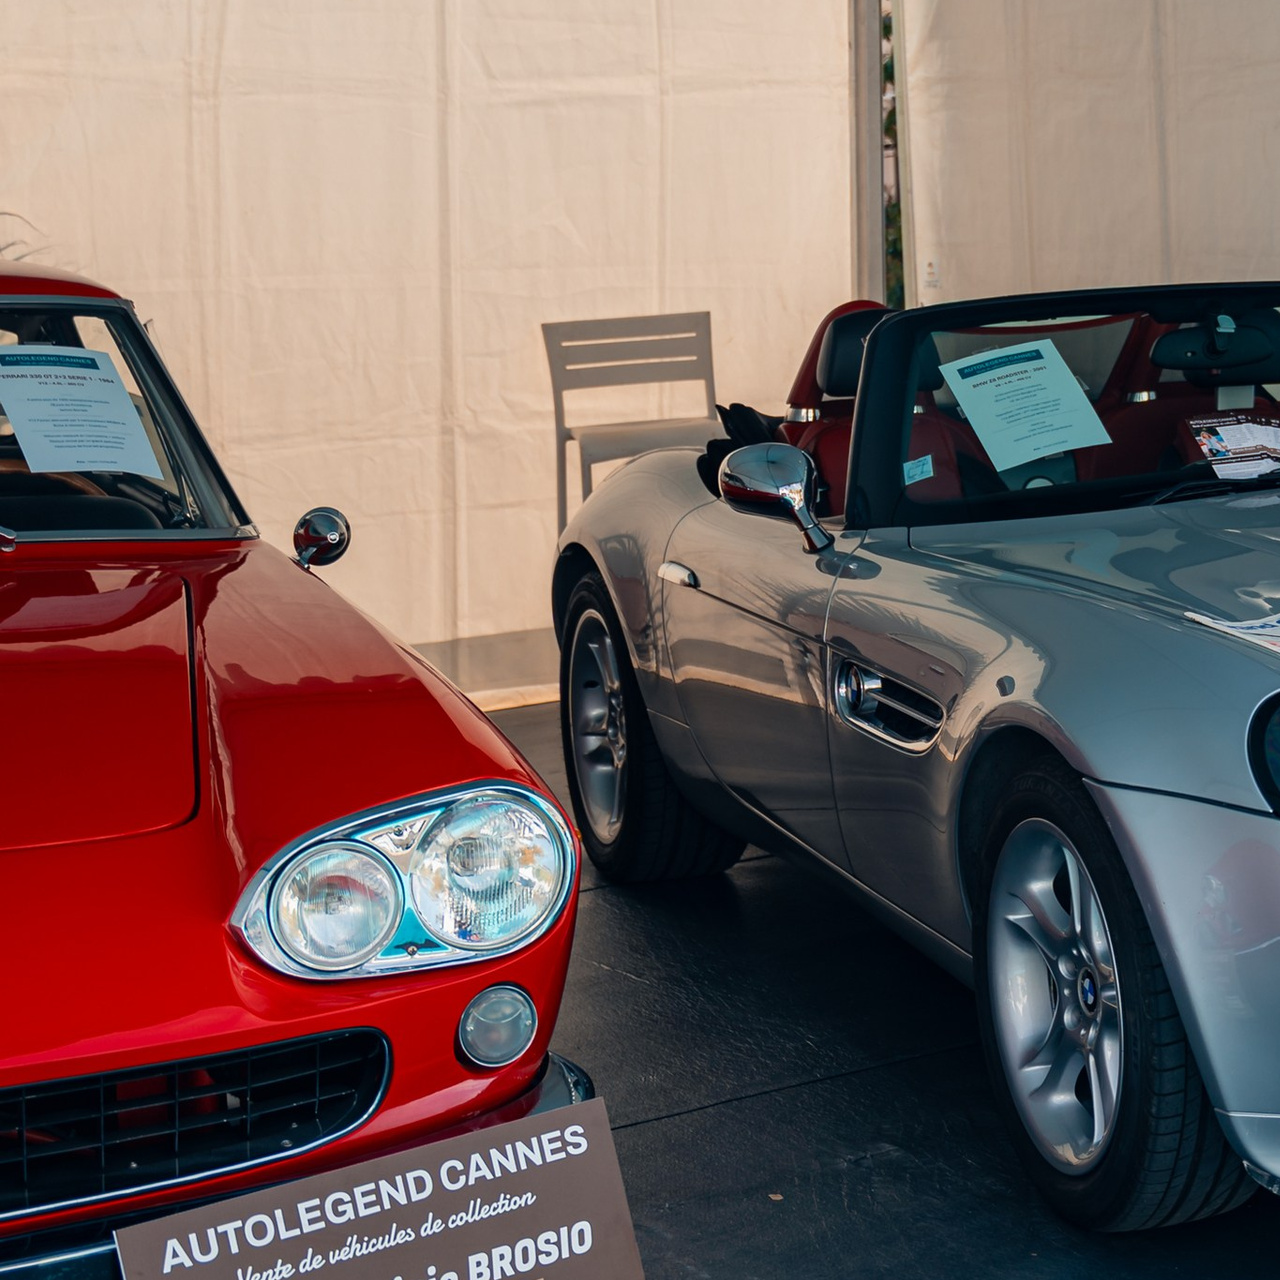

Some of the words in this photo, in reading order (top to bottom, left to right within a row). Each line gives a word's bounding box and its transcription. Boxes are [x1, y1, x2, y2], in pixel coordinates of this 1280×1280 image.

[162, 1167, 434, 1275] AUTOLEGEND
[440, 1123, 590, 1192] CANNES
[299, 1243, 326, 1276] de
[328, 1224, 417, 1263] véhicules
[419, 1213, 445, 1237] de
[447, 1191, 536, 1232] collection
